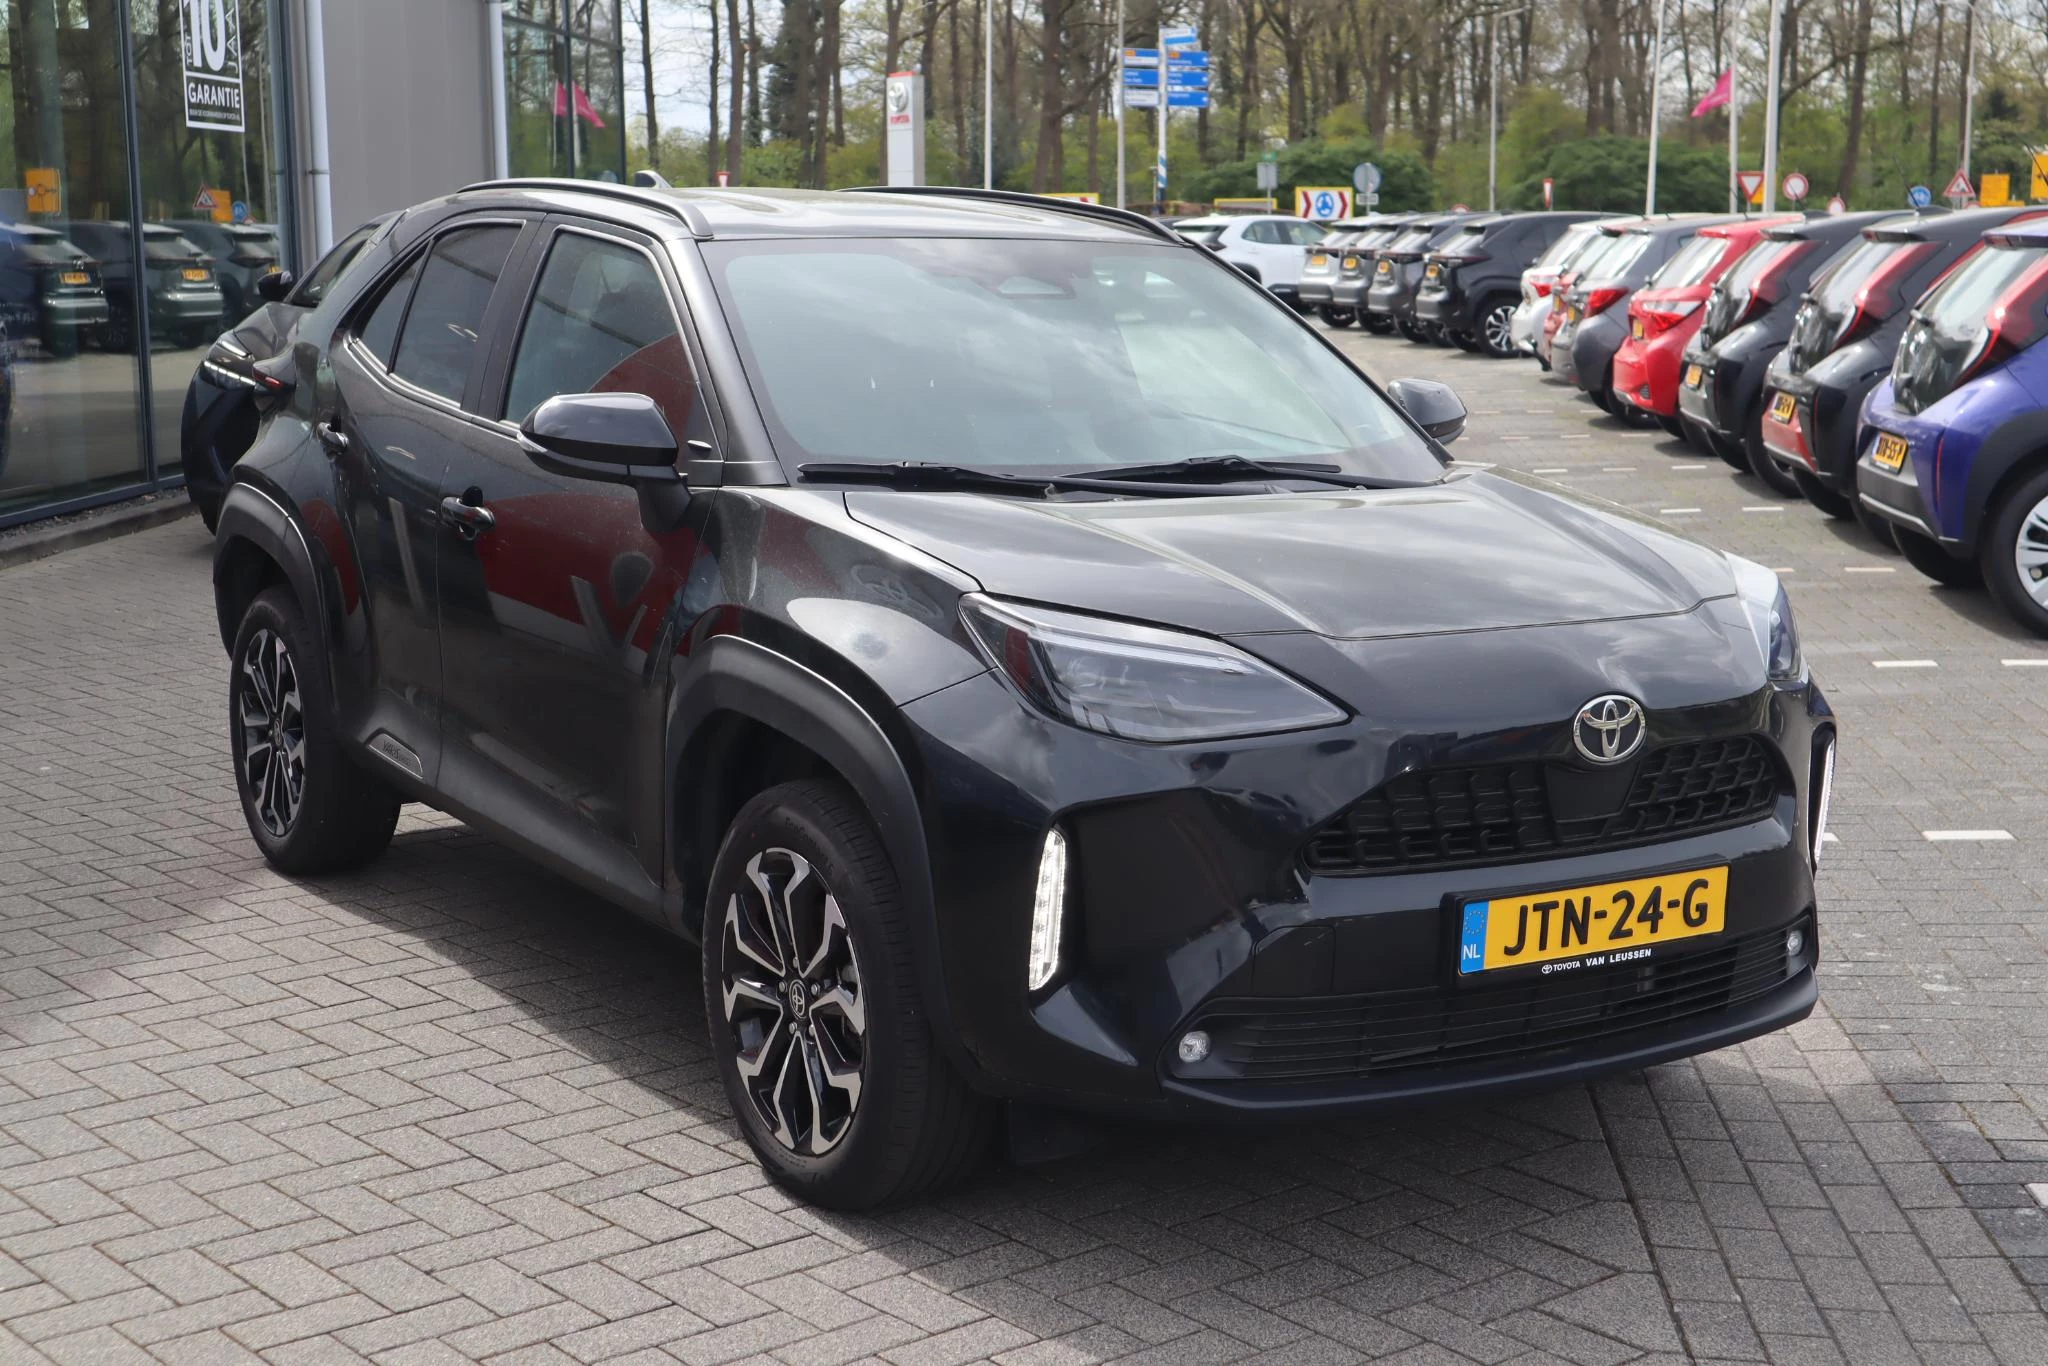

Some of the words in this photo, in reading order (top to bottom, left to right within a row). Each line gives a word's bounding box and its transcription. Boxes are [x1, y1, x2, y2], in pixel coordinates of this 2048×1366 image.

[182, 0, 226, 72] 10
[184, 34, 194, 66] TOT
[225, 6, 238, 74] JAA
[188, 82, 240, 109] GARANTIE
[1503, 878, 1709, 956] JTN-24-G
[1463, 944, 1481, 960] NL
[1553, 961, 1581, 972] TOYOTA
[1586, 956, 1605, 967] VAN
[1610, 949, 1652, 964] LEUSSEN
